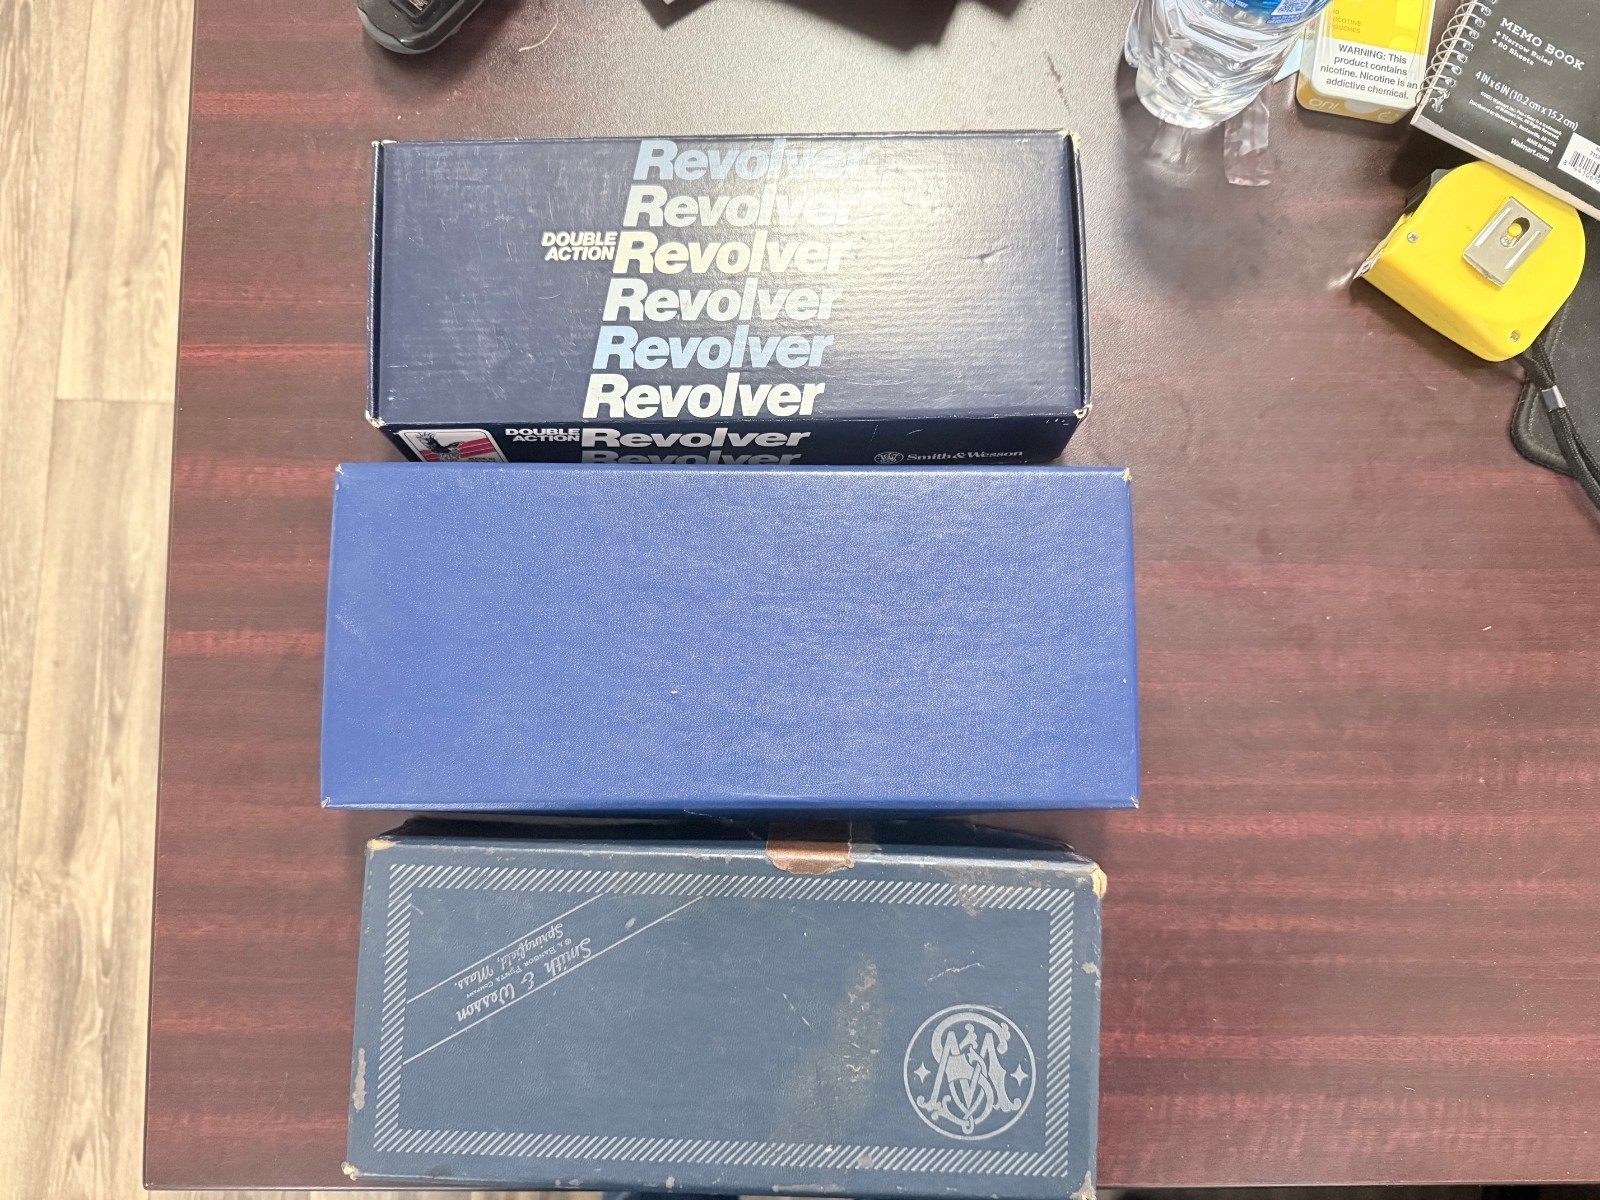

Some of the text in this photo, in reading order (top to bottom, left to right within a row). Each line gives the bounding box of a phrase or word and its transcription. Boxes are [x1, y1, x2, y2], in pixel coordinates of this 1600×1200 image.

[1332, 24, 1361, 34] OUCHES
[1338, 43, 1407, 64] WARNING: This
[1498, 42, 1508, 50] 80
[1508, 48, 1535, 66] Sheets
[1500, 17, 1585, 70] MEMO BOOK
[1501, 33, 1530, 53] Narrow
[1530, 50, 1553, 66] Ruled
[1320, 64, 1357, 78] nicotine.
[1360, 71, 1395, 85] Nicotine
[1397, 78, 1405, 87] is
[1334, 56, 1408, 76] product contains
[1326, 77, 1409, 99] addictive chemical.
[1509, 89, 1530, 106] (10.2
[1529, 101, 1541, 112] cm
[1548, 108, 1564, 123] 15.2
[1563, 117, 1579, 131] cm)
[633, 138, 870, 180] Revolver
[1511, 137, 1550, 162] Walmart.com
[622, 184, 861, 227] Revolver
[541, 231, 618, 247] DOUBLE
[544, 246, 616, 261] ACTION
[612, 231, 851, 274] Revolver
[602, 278, 843, 321] Revolver
[592, 325, 834, 370] Revolver
[582, 372, 825, 418] Revolver
[505, 428, 581, 436] DOUBLE
[581, 428, 811, 448] Revolver
[581, 450, 801, 465] Revolver
[454, 923, 564, 990] Springfield, Mass.
[455, 937, 592, 1022] Smith & Wesson
